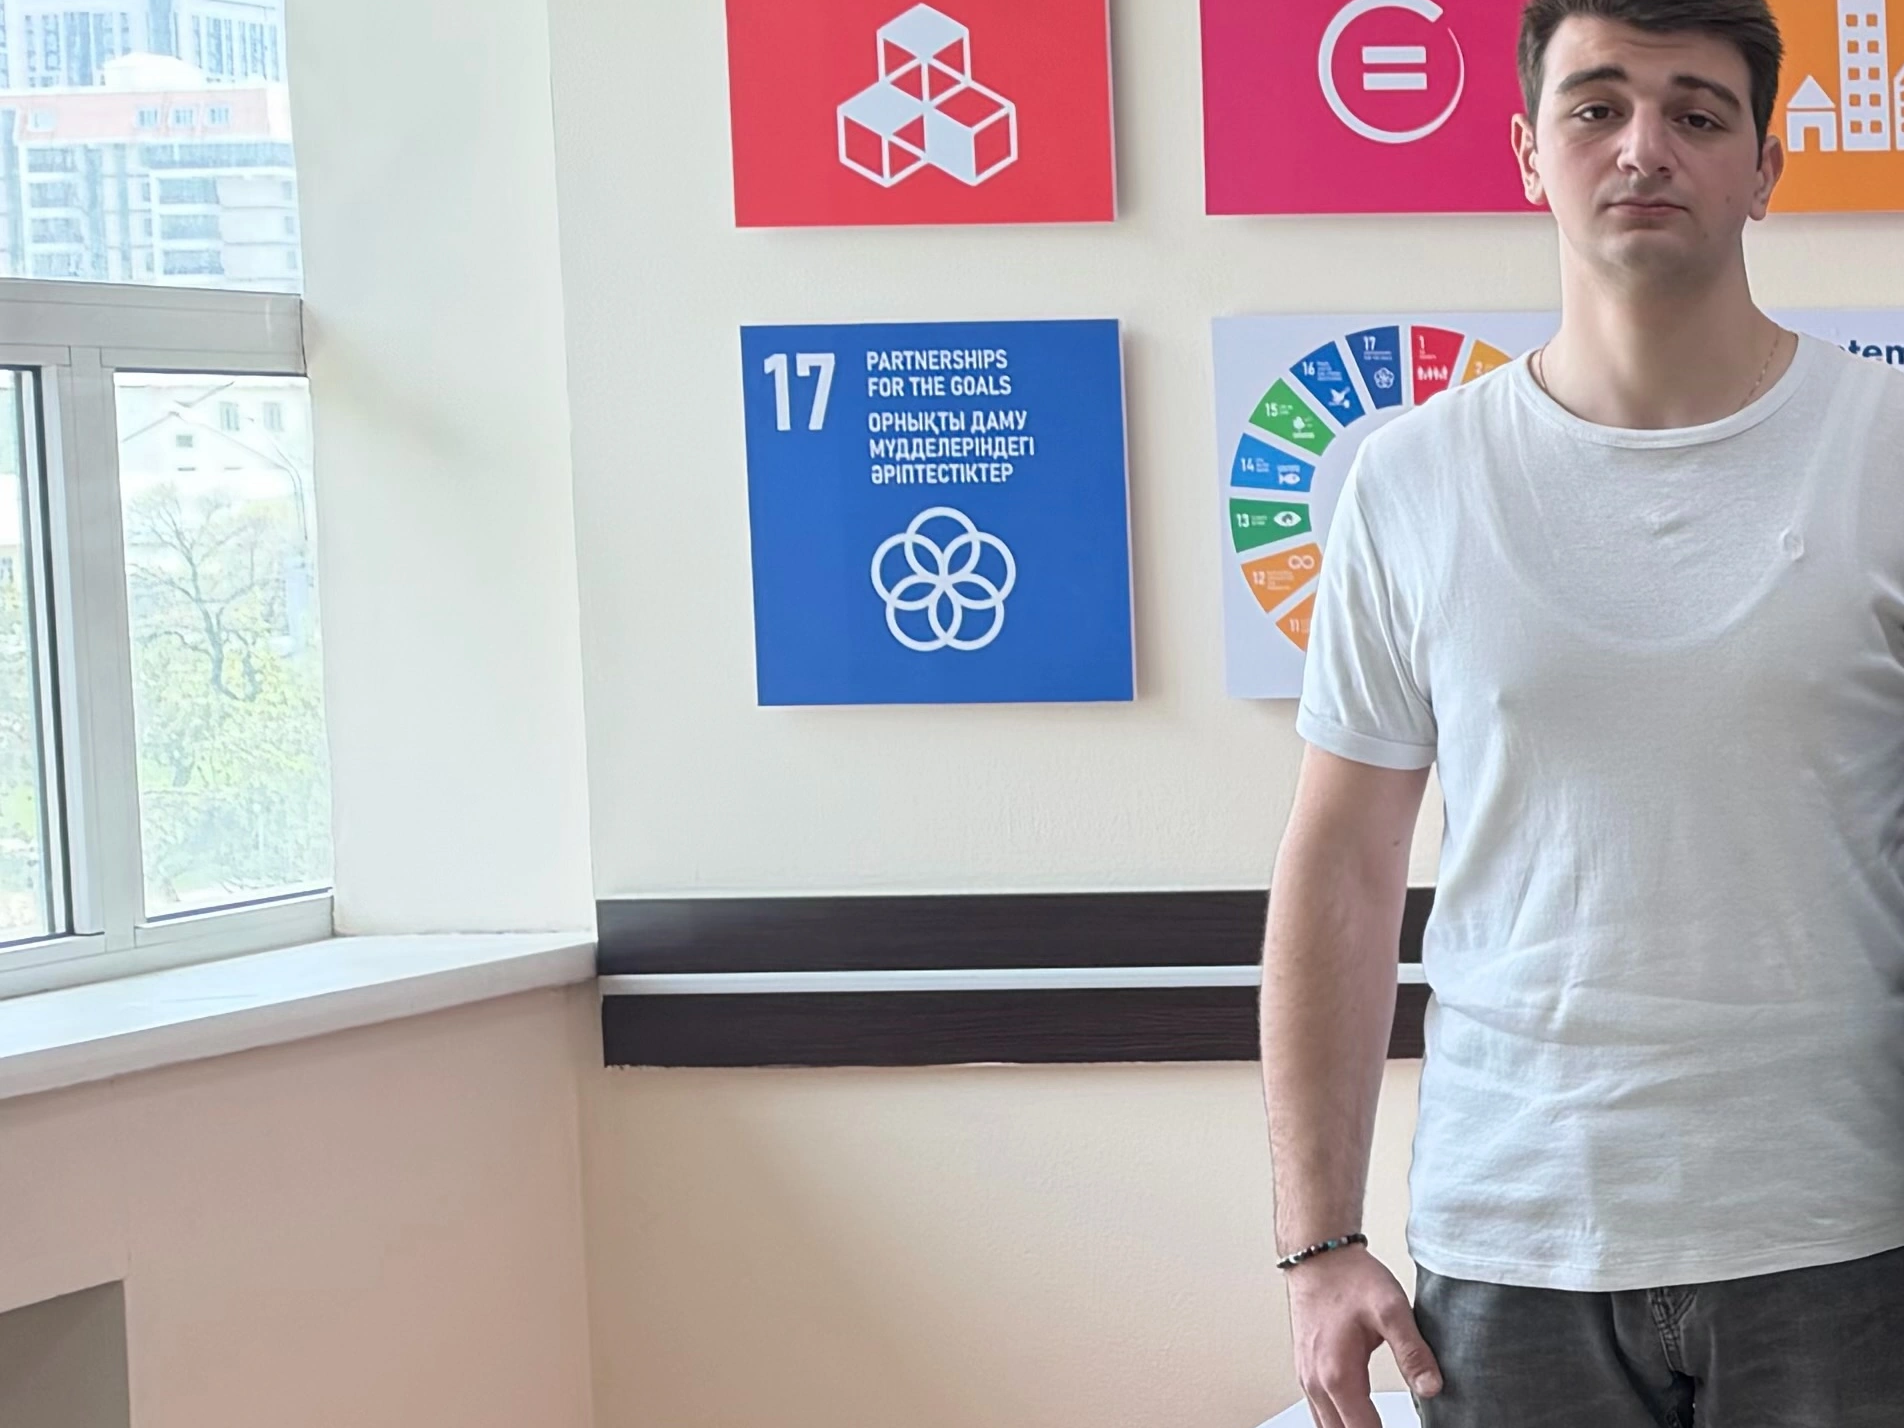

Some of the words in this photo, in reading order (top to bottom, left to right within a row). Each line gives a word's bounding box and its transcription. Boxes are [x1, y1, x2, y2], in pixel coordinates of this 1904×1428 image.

[1363, 336, 1376, 350] 17
[867, 349, 1007, 370] PARTNERSHIPS
[1302, 361, 1315, 375] 16
[764, 353, 835, 430] 17
[869, 377, 904, 396] FOR
[909, 376, 945, 396] THE
[951, 376, 1011, 395] GOALS
[1265, 403, 1278, 417] 15
[1241, 458, 1254, 471] 14
[1236, 513, 1249, 527] 13
